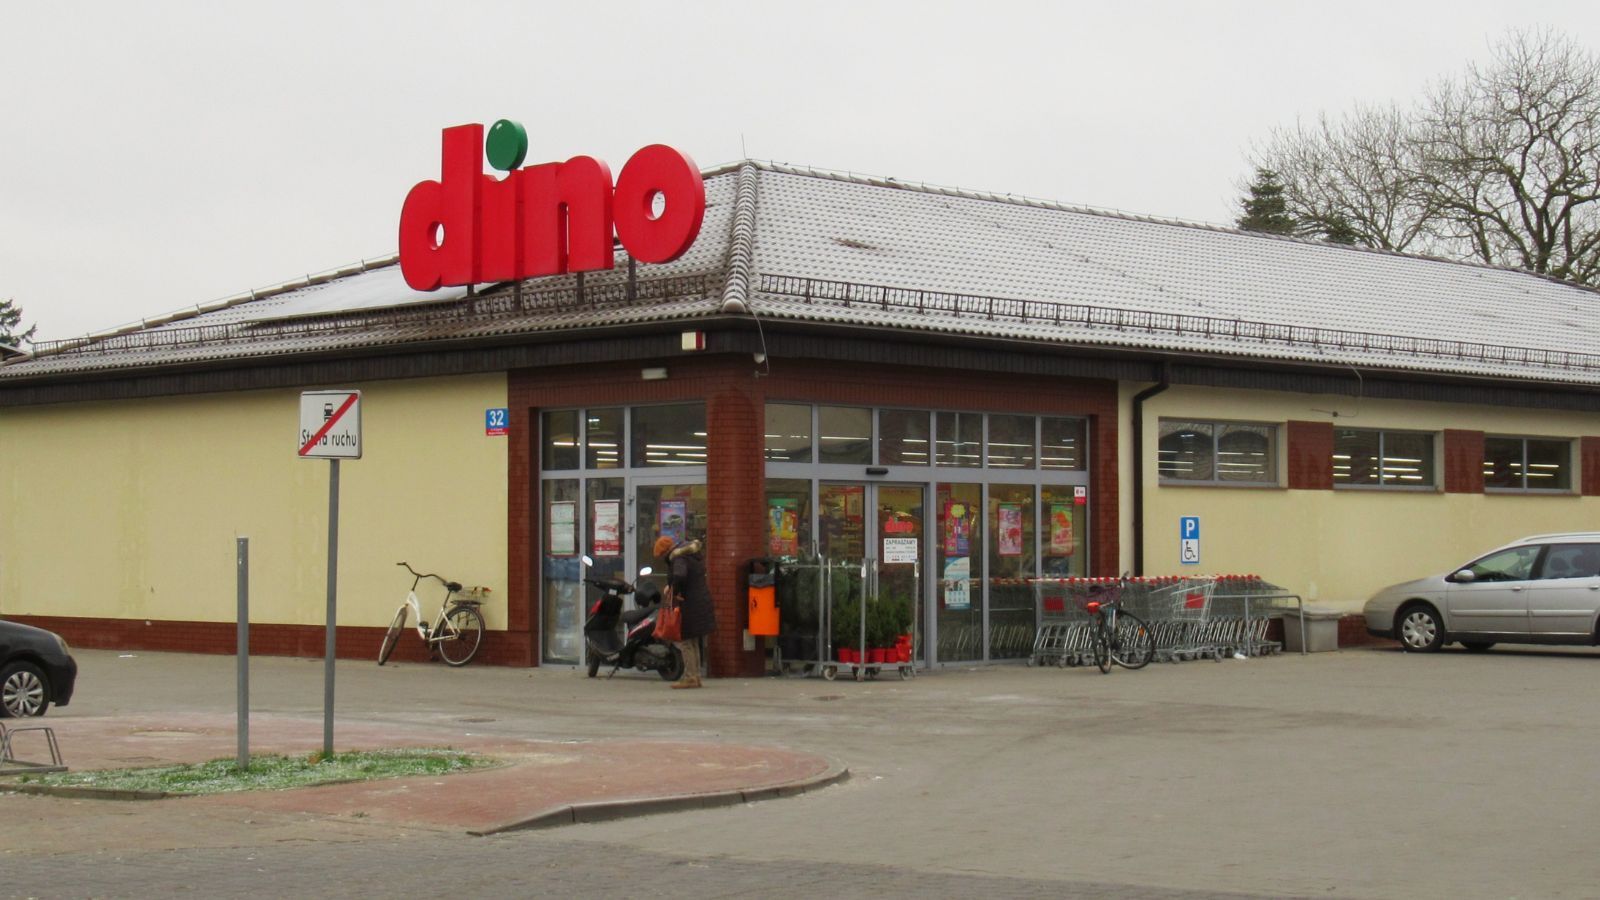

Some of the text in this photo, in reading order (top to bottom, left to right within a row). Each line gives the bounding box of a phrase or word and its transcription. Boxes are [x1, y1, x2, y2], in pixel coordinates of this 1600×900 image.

[399, 119, 705, 291] dino
[490, 410, 504, 426] 32
[301, 429, 357, 447] Sta ruchu
[1186, 519, 1195, 537] P
